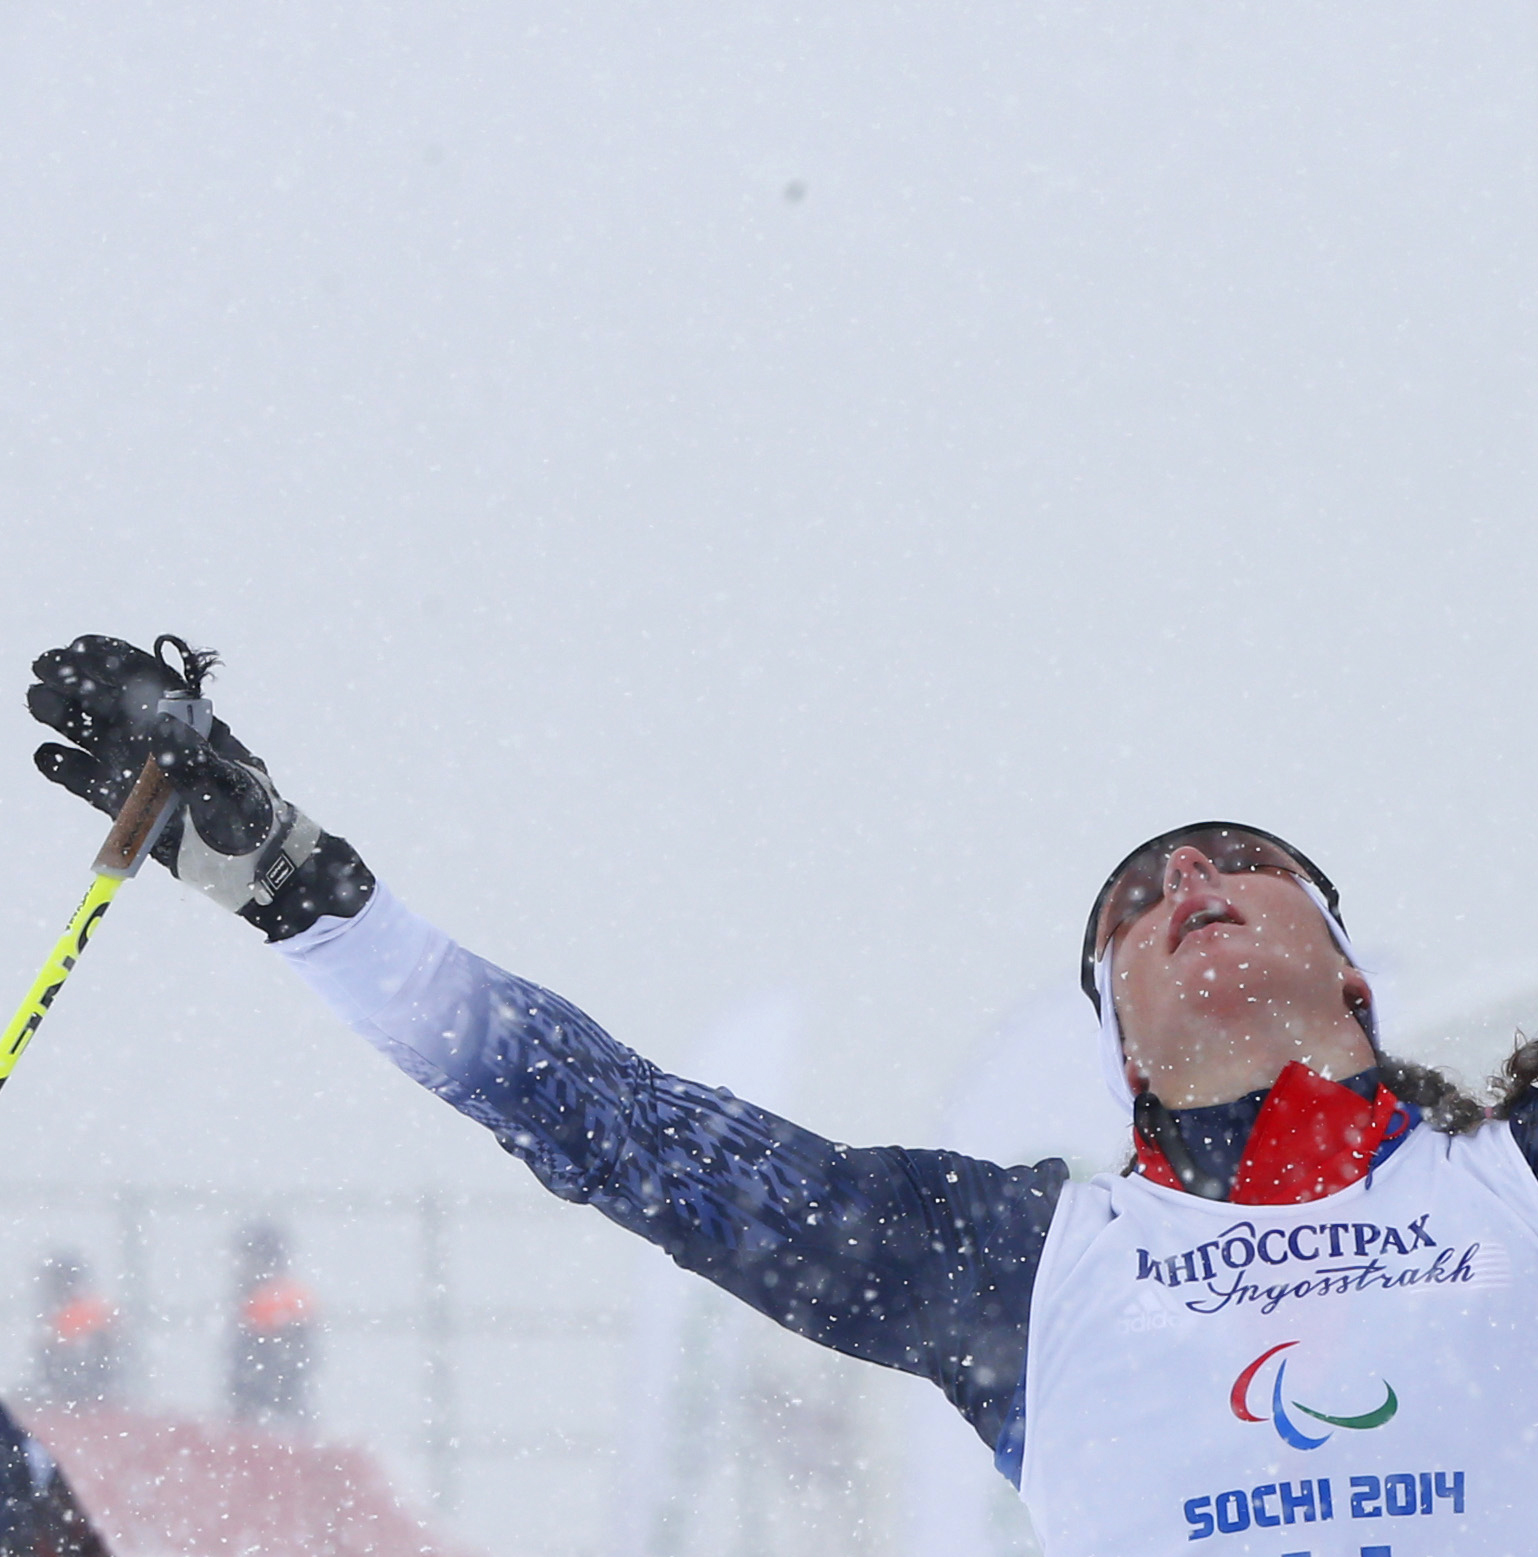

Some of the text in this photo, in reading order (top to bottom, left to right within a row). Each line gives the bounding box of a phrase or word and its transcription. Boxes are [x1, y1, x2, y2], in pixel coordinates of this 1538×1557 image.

[1136, 1214, 1437, 1287] ИНГОССТРАХ
[1185, 1242, 1480, 1314] Ingosstrakh
[1184, 1472, 1465, 1541] SOCHI 2014
